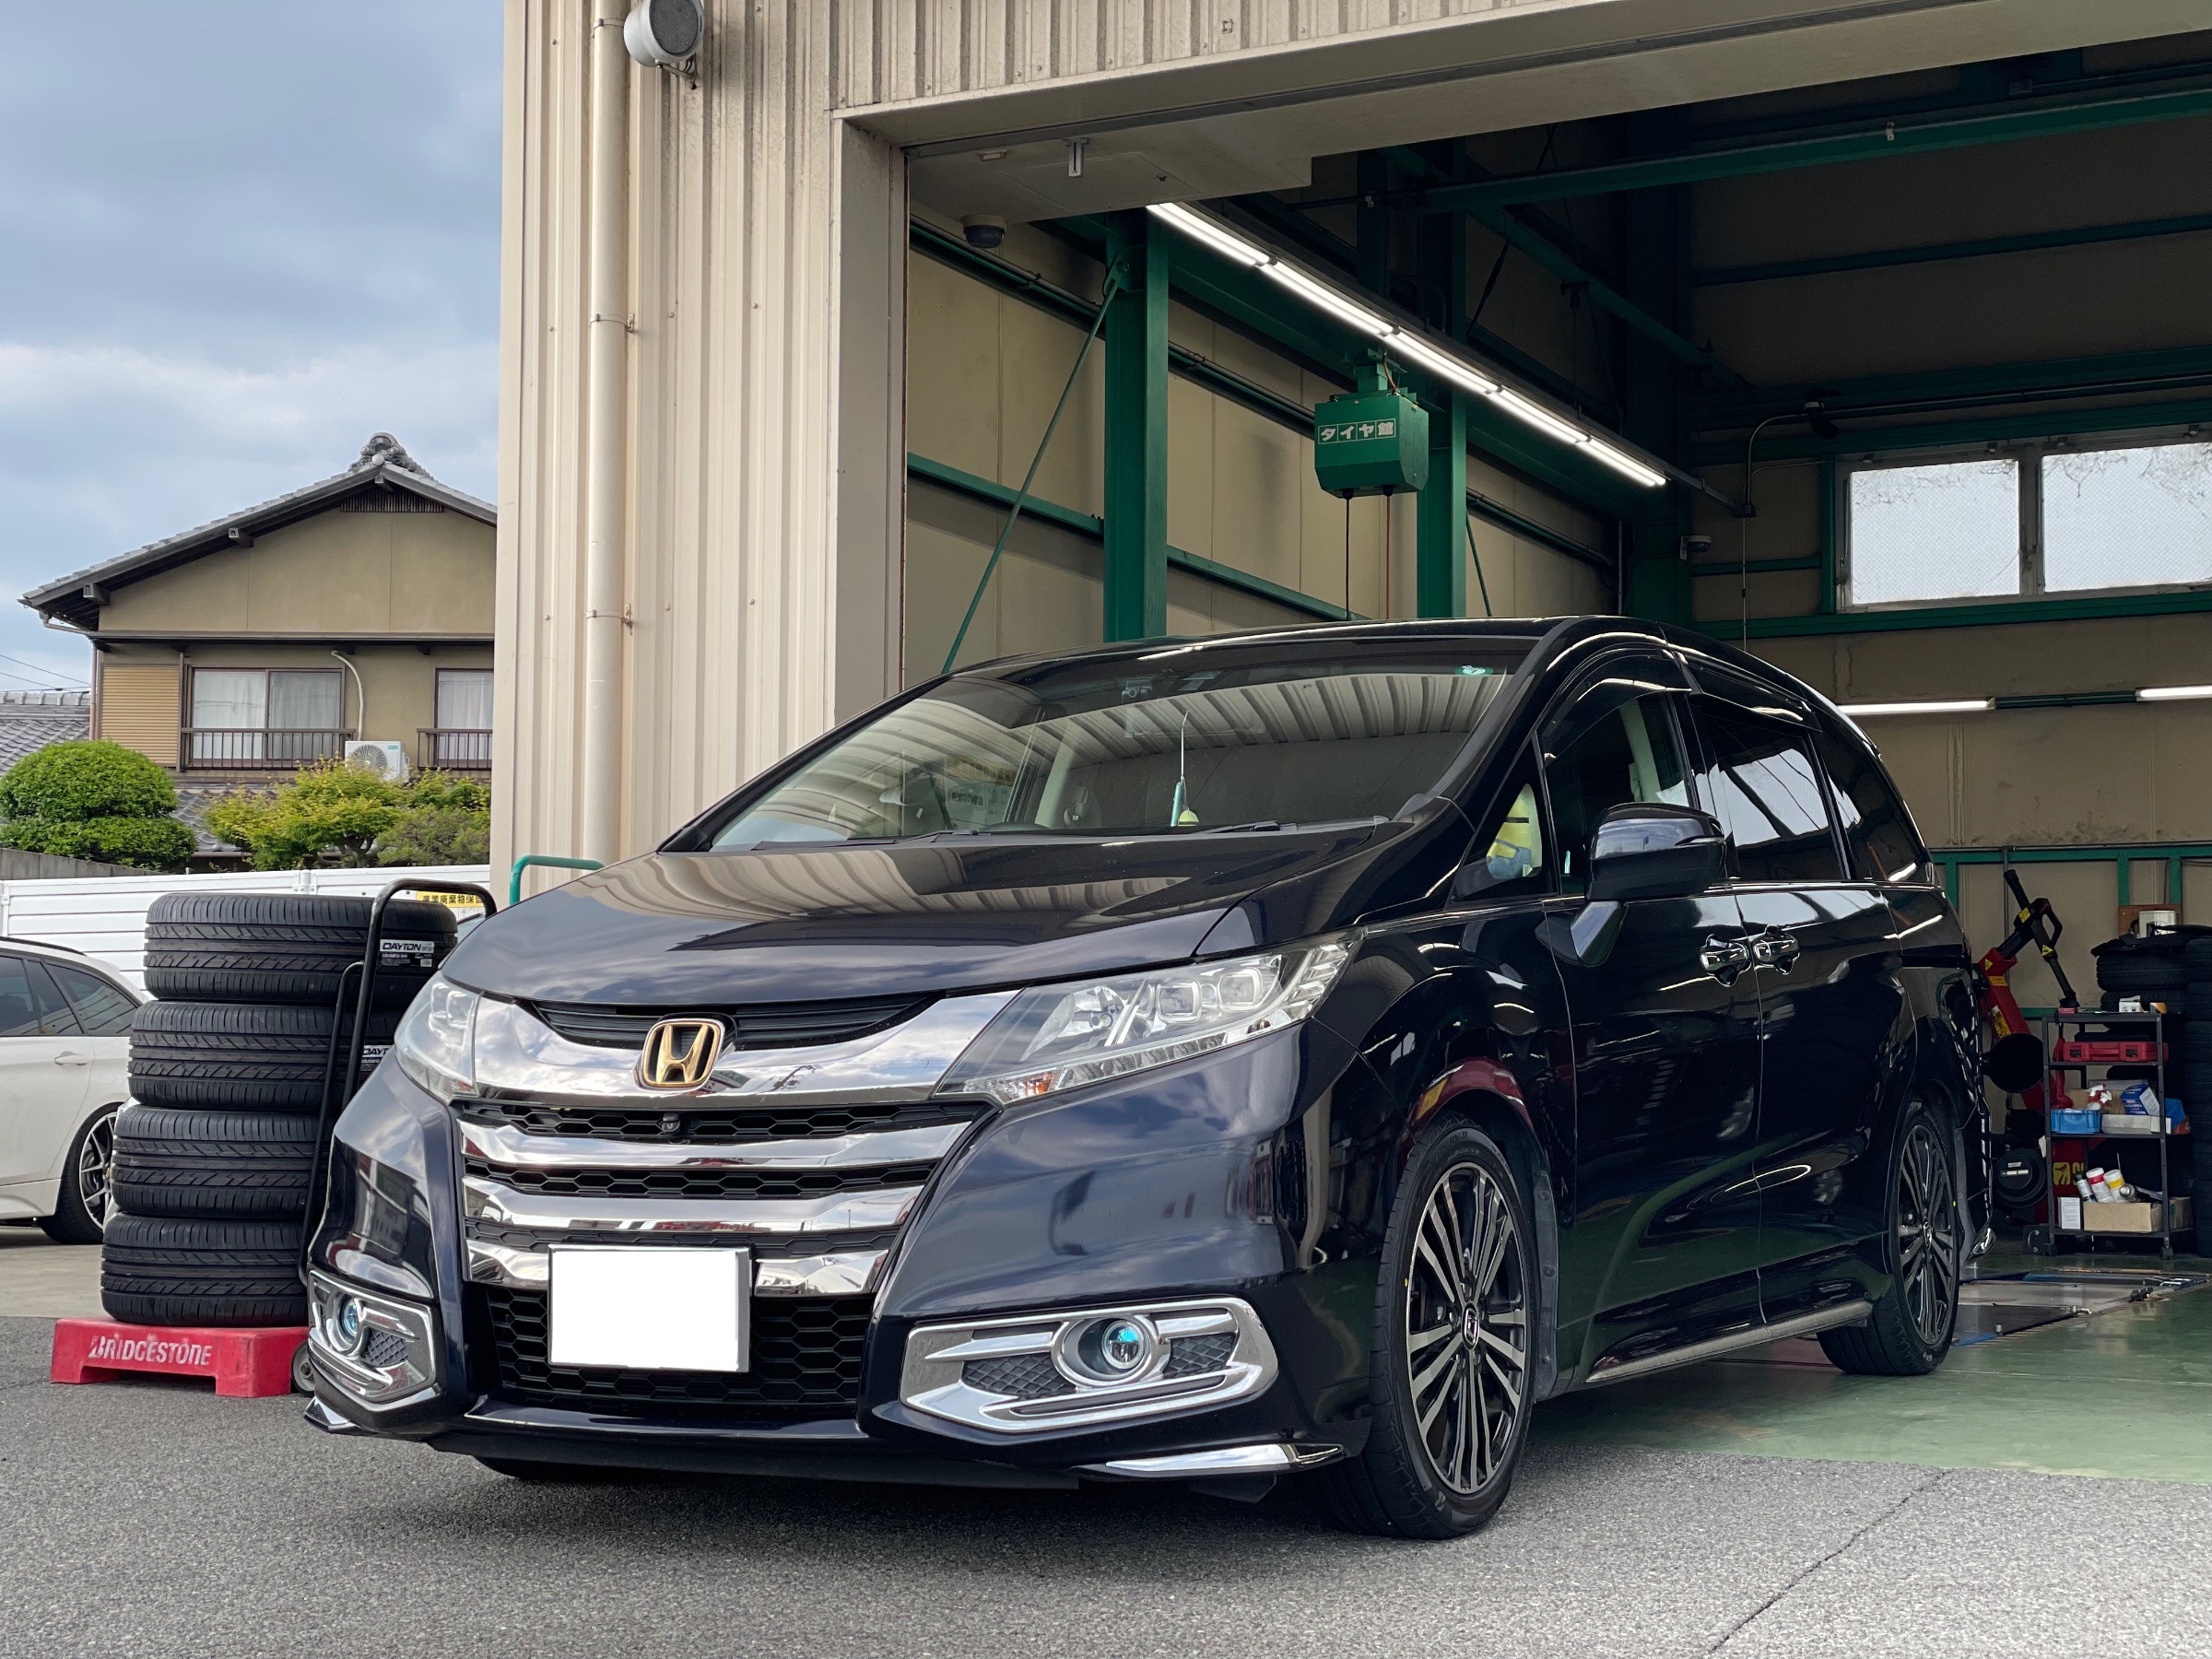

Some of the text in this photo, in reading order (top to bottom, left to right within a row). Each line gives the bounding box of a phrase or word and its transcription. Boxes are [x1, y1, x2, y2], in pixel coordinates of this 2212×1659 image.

[1320, 421, 1394, 441] タイヤ館
[382, 943, 421, 951] DAYTON
[88, 1335, 213, 1366] BRIDGESTONE
